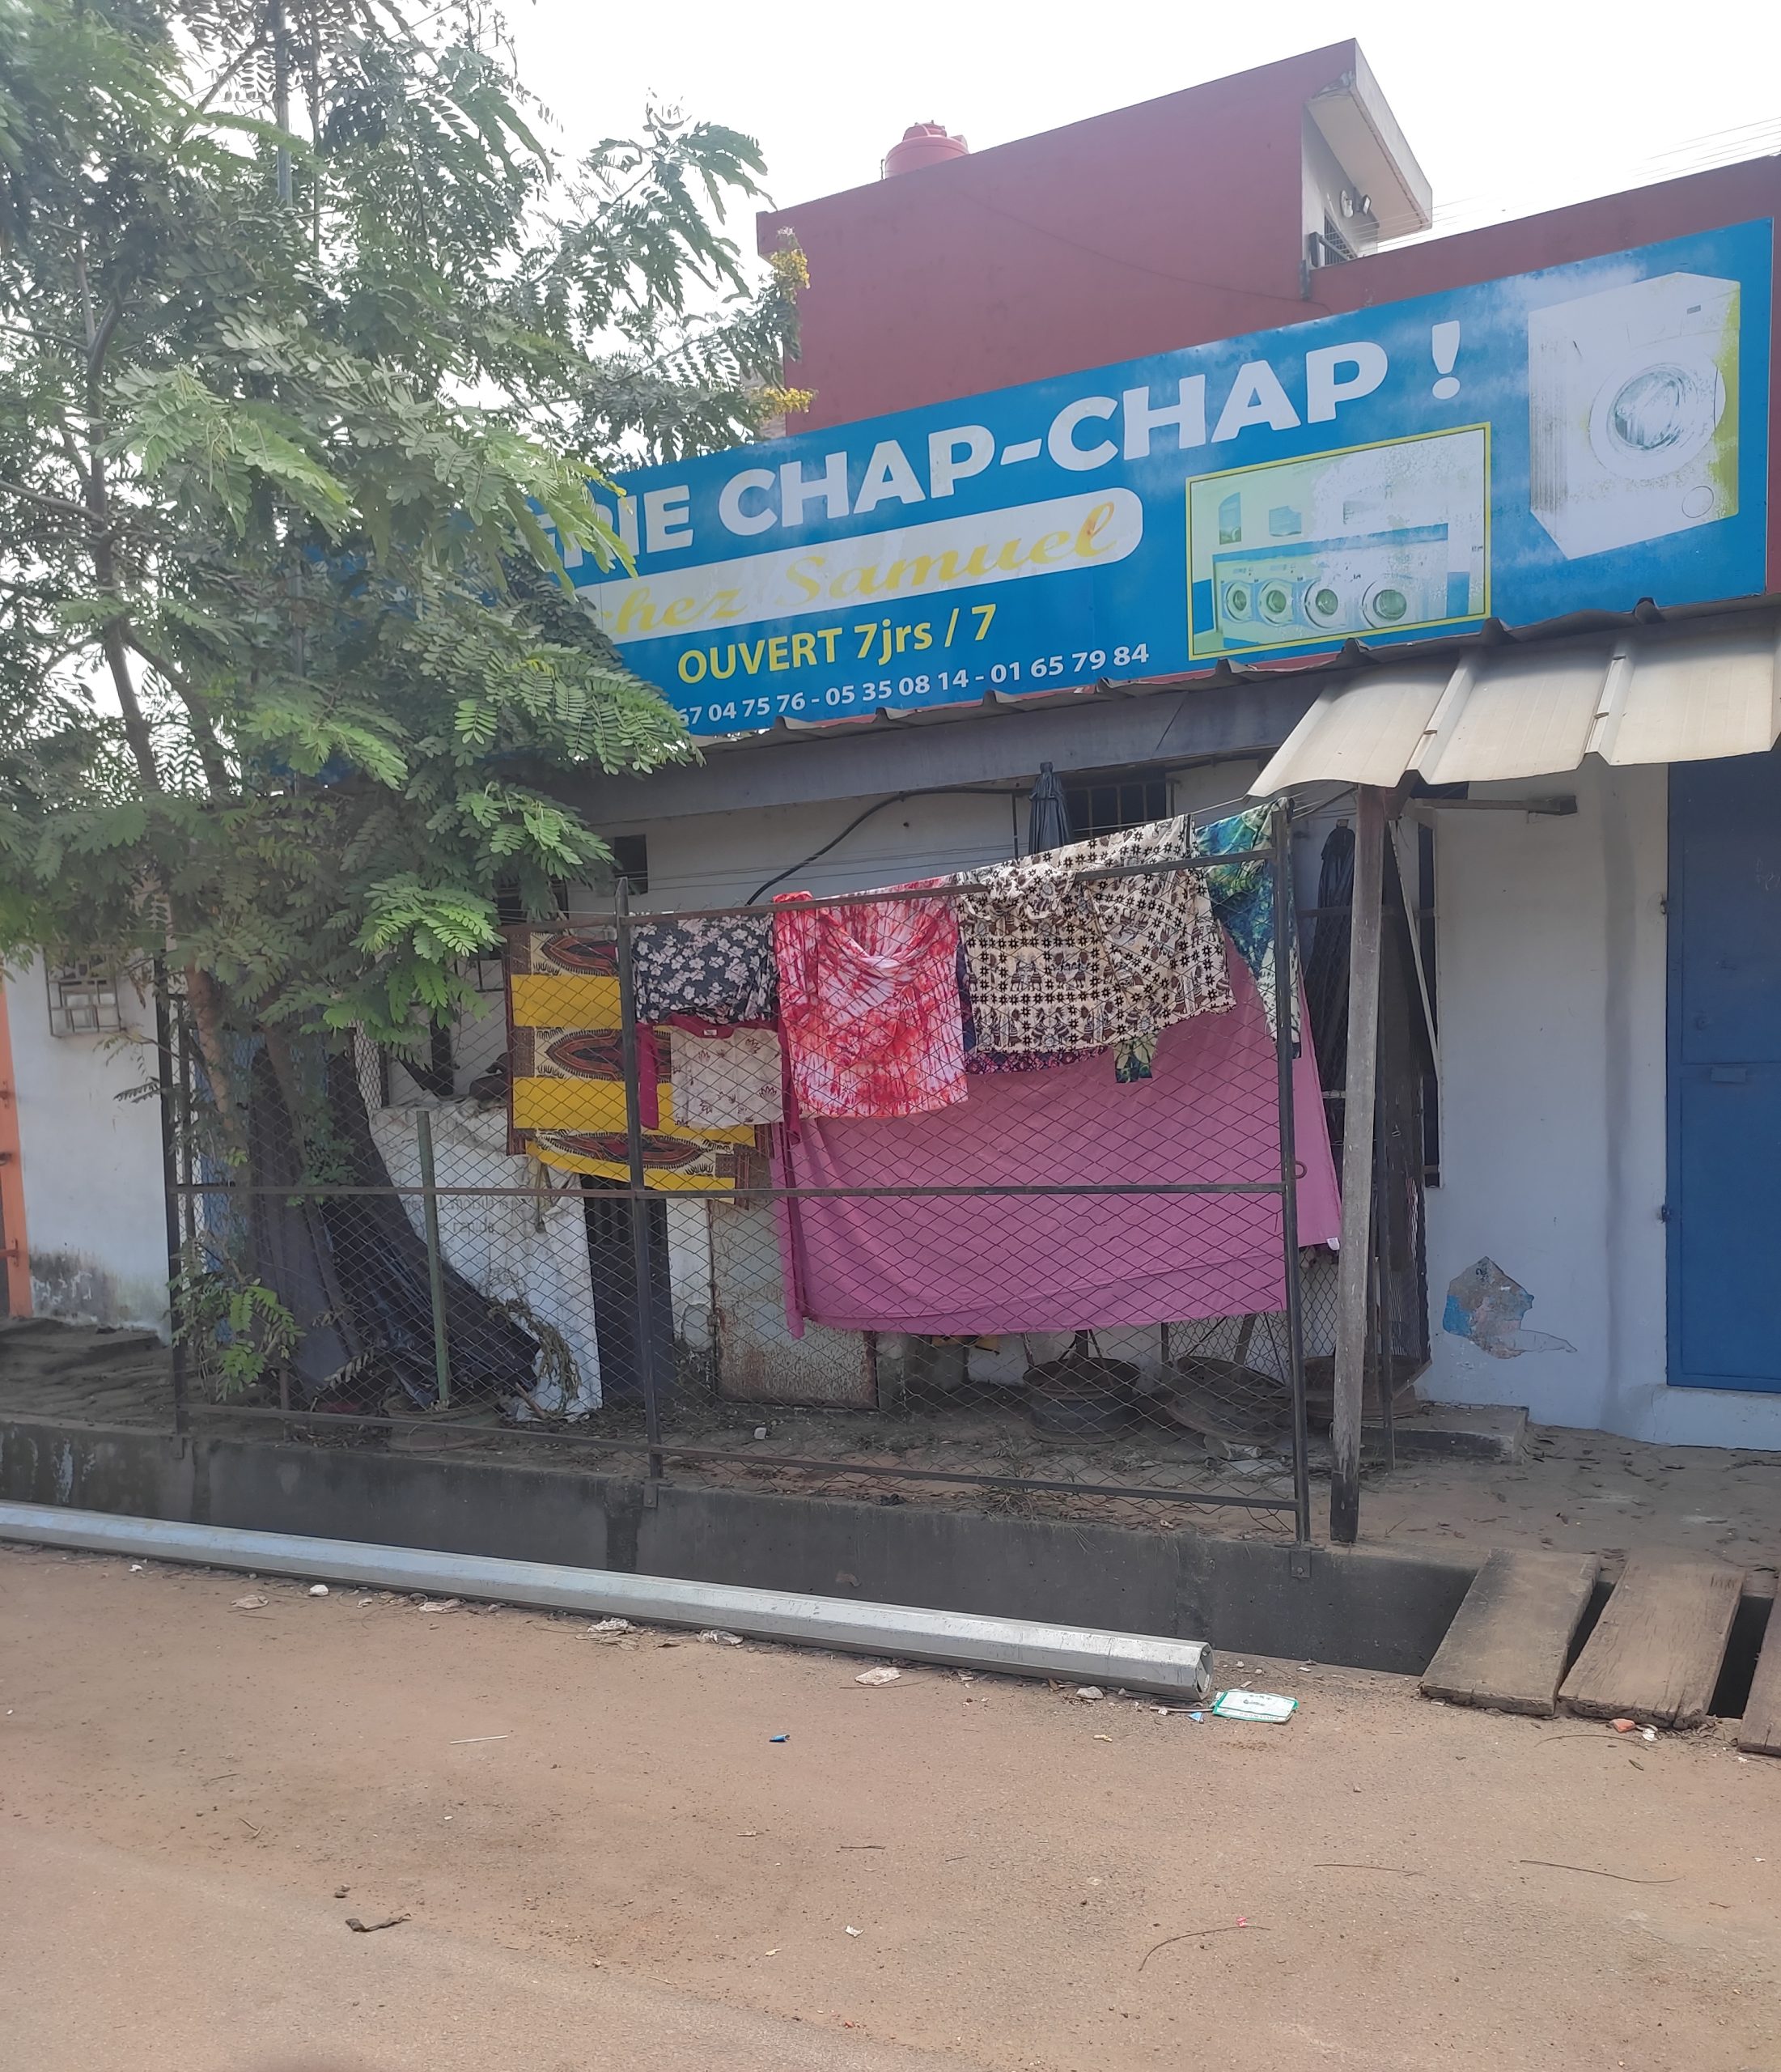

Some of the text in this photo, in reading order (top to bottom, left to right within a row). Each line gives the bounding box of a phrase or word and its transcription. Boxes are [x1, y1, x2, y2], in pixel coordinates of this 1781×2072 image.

[719, 341, 1389, 536] CHAP-CHAP
[1431, 320, 1461, 400] !
[600, 501, 1117, 635] hez Samuel
[677, 603, 997, 684] OUVERT 7jrs / 7
[708, 702, 736, 721] 04
[742, 696, 770, 717] 75
[777, 692, 806, 712] 76
[825, 685, 854, 706] 05
[863, 680, 892, 702] 35
[899, 675, 931, 696] 08
[938, 669, 969, 690] 14
[990, 662, 1020, 683] 01
[1030, 656, 1064, 677] 65
[1072, 650, 1106, 672] 79
[1113, 643, 1149, 666] 84
